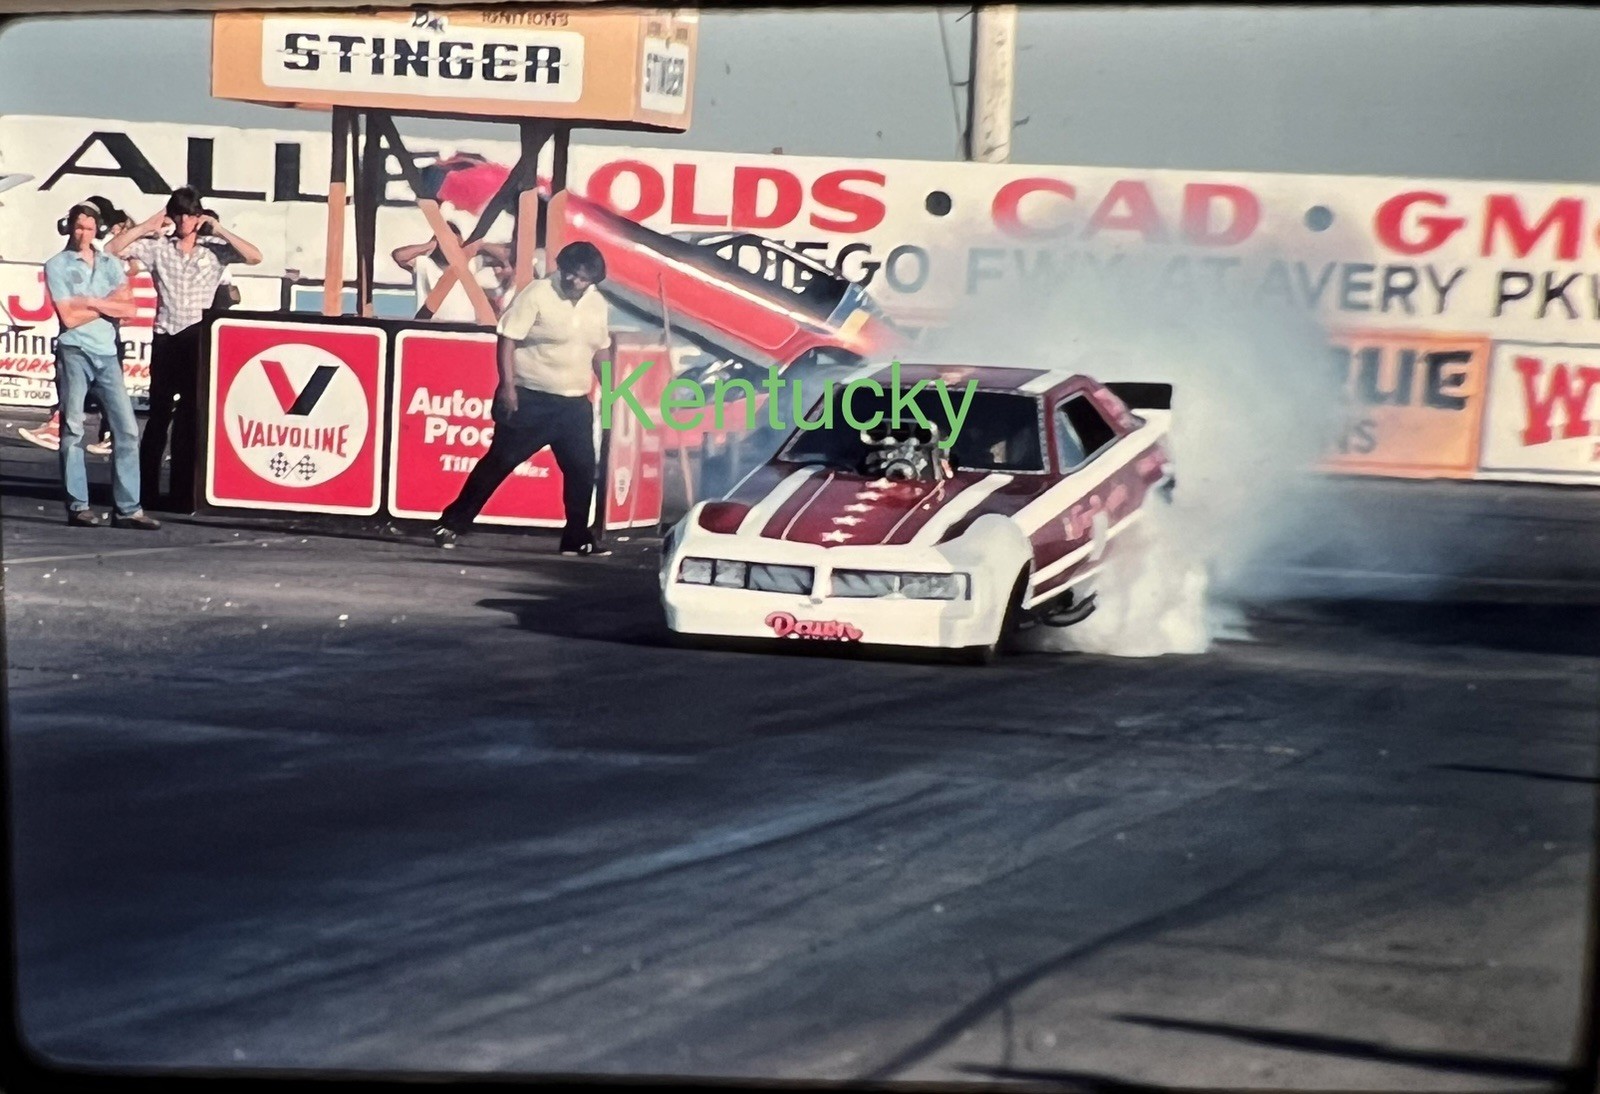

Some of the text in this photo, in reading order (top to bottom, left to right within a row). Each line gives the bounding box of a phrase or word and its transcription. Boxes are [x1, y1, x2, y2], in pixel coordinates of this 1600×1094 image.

[283, 33, 561, 84] STINGER
[587, 159, 886, 234] OLDS
[991, 177, 1262, 247] CAD
[1374, 190, 1600, 261] GM
[237, 414, 350, 458] VALVOLINE
